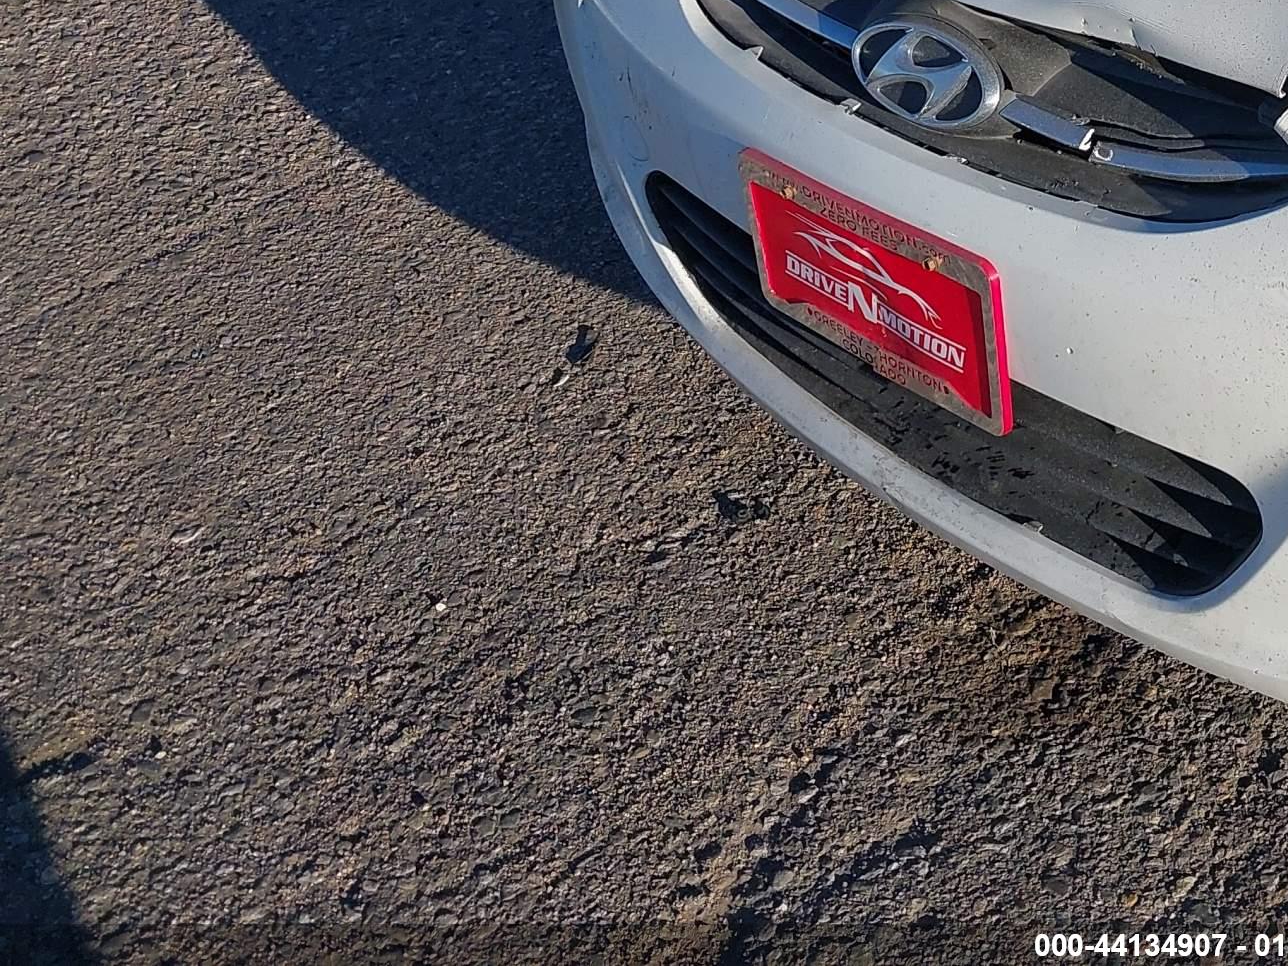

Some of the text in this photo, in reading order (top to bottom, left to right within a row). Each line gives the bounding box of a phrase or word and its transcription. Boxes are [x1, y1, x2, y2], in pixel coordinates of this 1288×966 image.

[820, 208, 898, 251] ZERO FEES
[813, 311, 864, 347] GREELEY
